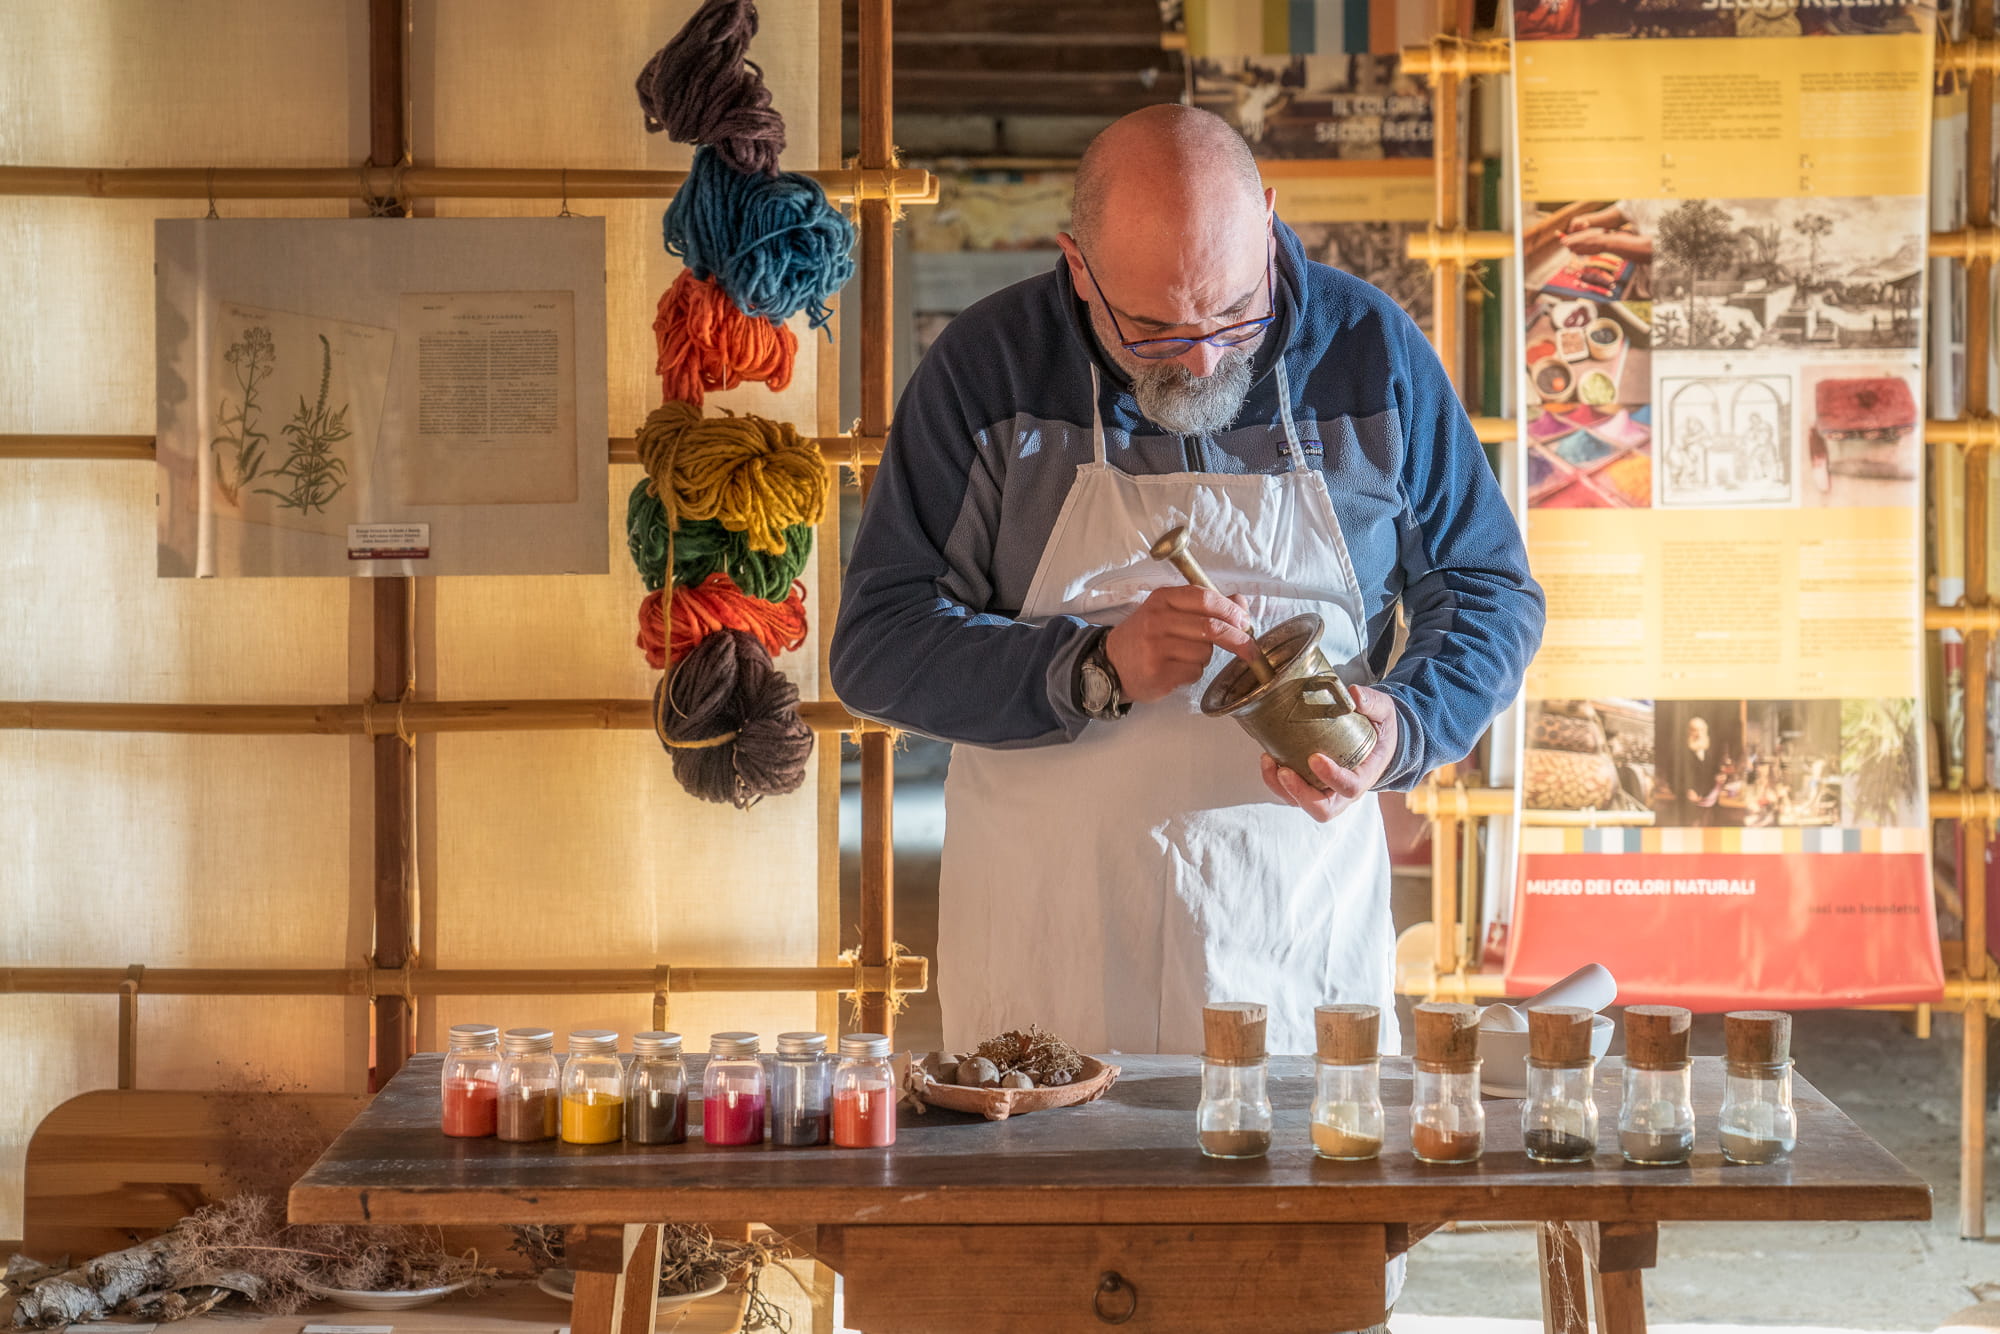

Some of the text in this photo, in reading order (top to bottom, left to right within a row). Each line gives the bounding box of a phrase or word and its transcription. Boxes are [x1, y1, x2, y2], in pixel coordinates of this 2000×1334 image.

[1526, 879, 1755, 895] MUSEO DEI COLORI NATURALI
